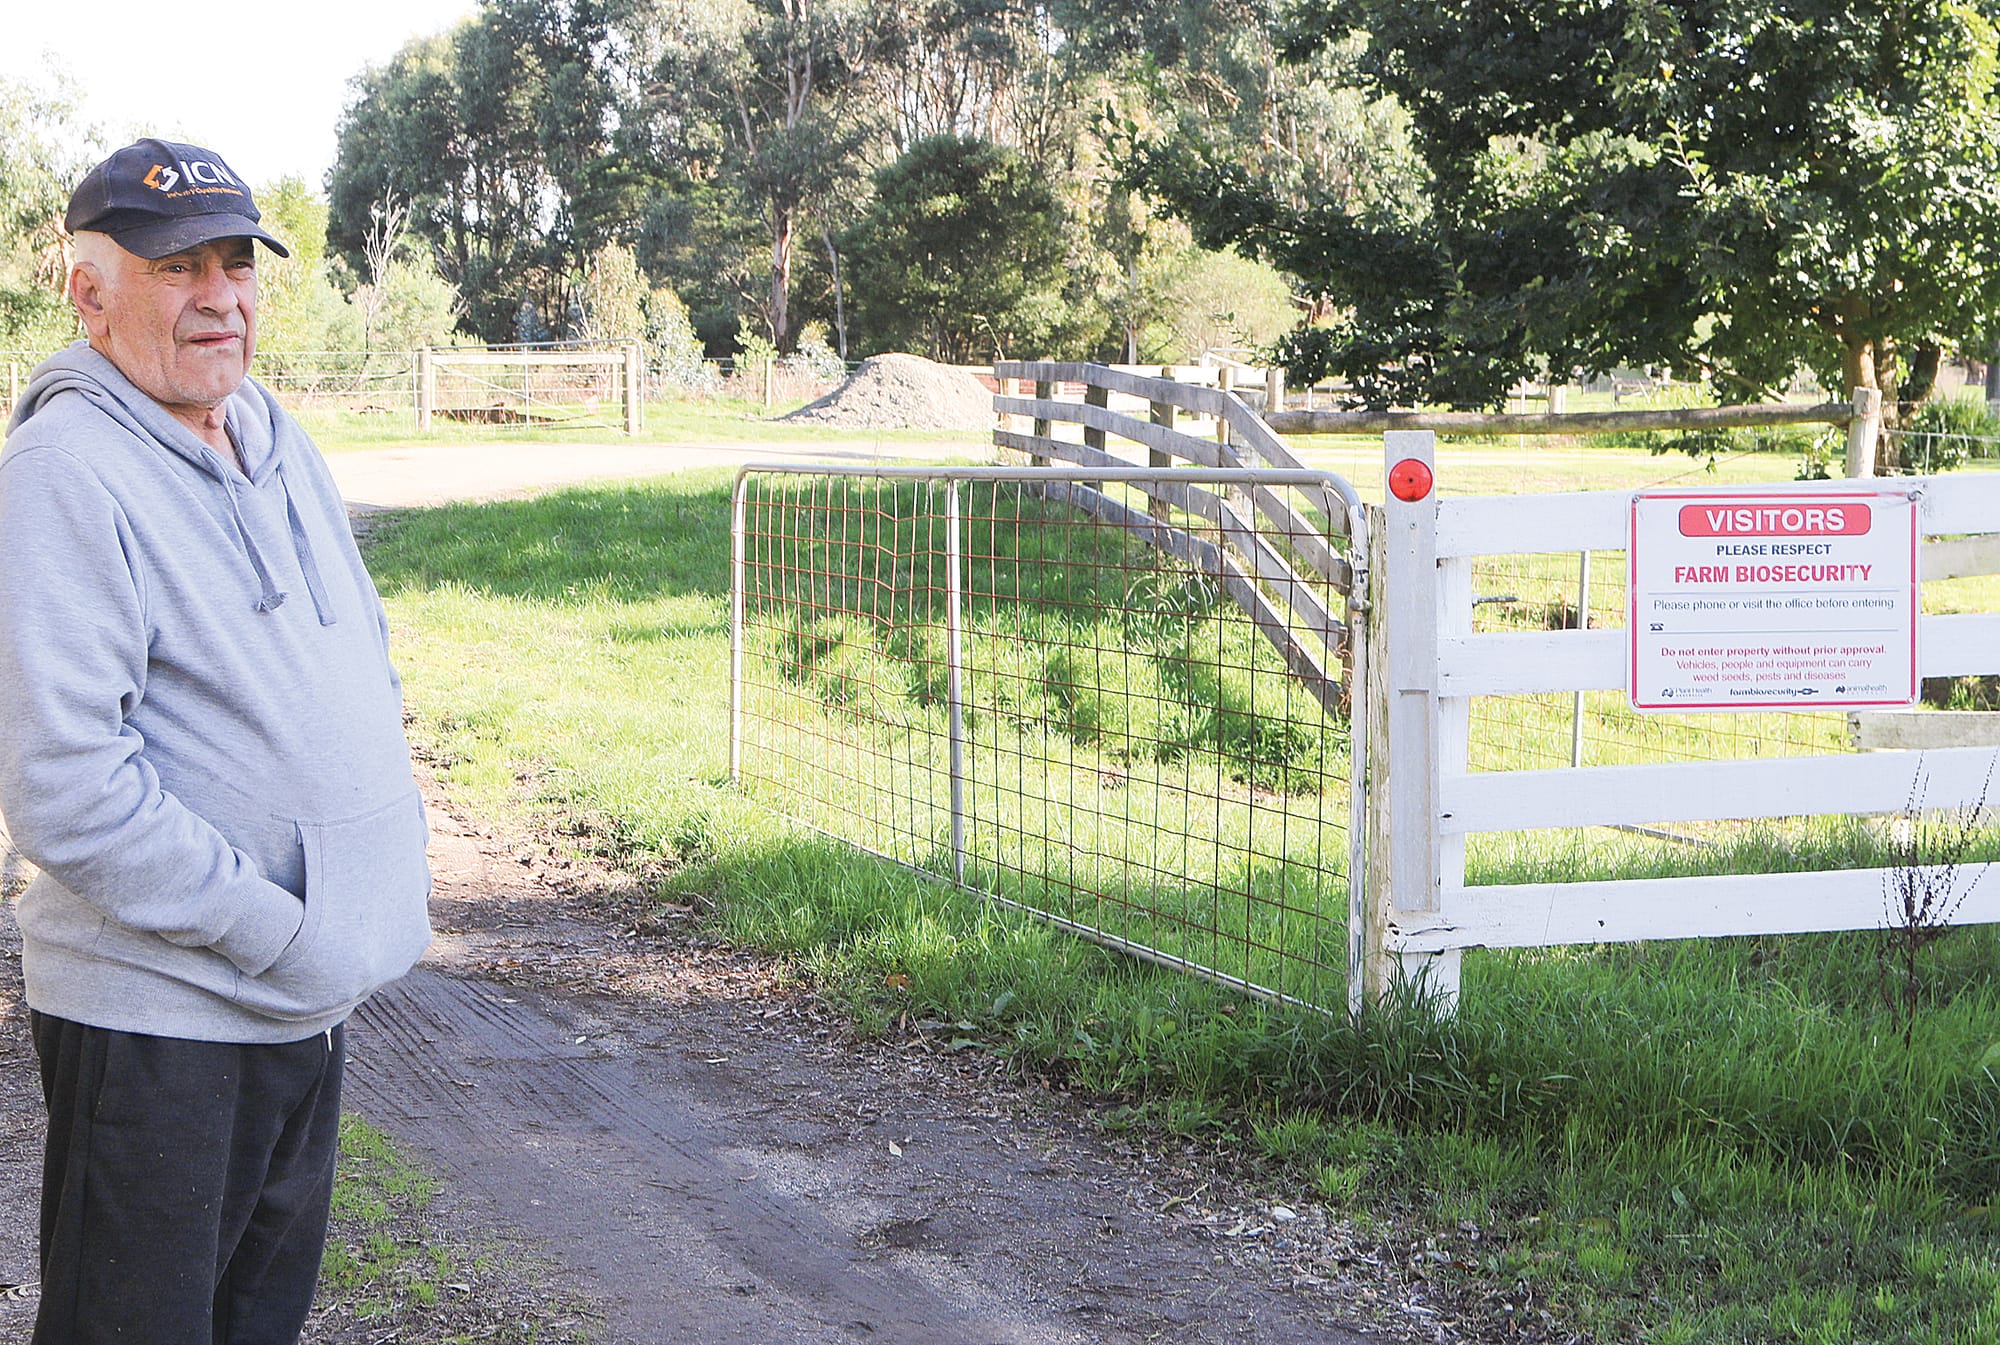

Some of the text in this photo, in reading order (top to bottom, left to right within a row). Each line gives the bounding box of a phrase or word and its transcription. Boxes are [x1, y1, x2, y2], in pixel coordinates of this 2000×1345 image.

[179, 161, 237, 187] ICN
[1706, 508, 1845, 532] VISITORS
[1717, 543, 1832, 556] PLEASE RESPECT
[1675, 564, 1872, 583] FARM BIOSECURITY
[1654, 598, 1894, 612] Please phone or visit the office before entering
[1661, 645, 1886, 657] Do not enter property without prior approval.
[1676, 658, 1872, 670] Vehicles, people and equipment can carry
[1693, 671, 1846, 683] weed seeds, pests and diseases
[1729, 687, 1797, 697] farmbiosecurity
